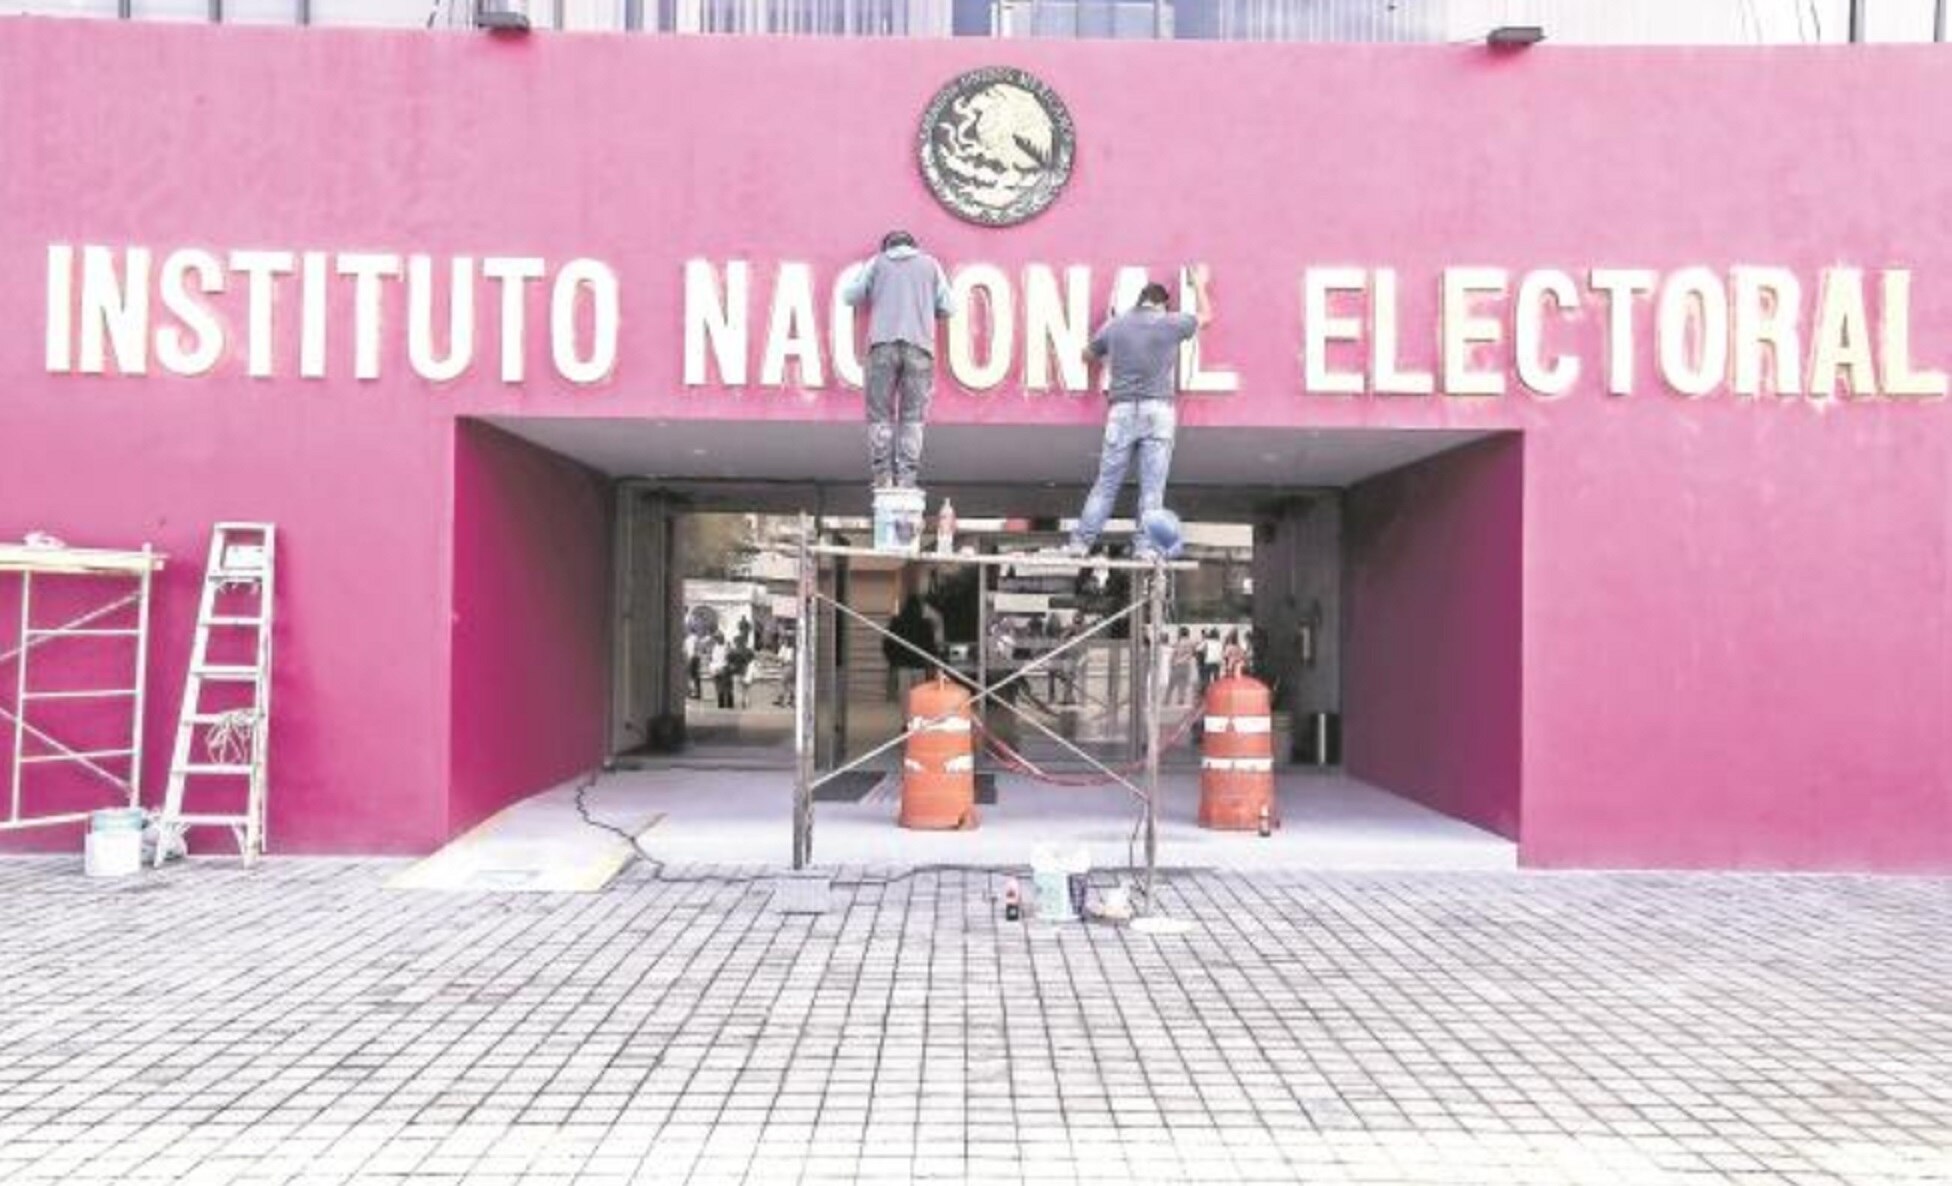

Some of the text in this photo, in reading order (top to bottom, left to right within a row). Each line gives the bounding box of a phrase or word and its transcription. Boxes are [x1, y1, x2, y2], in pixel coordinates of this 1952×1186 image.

[44, 245, 1947, 397] INSTITUTO NACONL ELECTORAL
